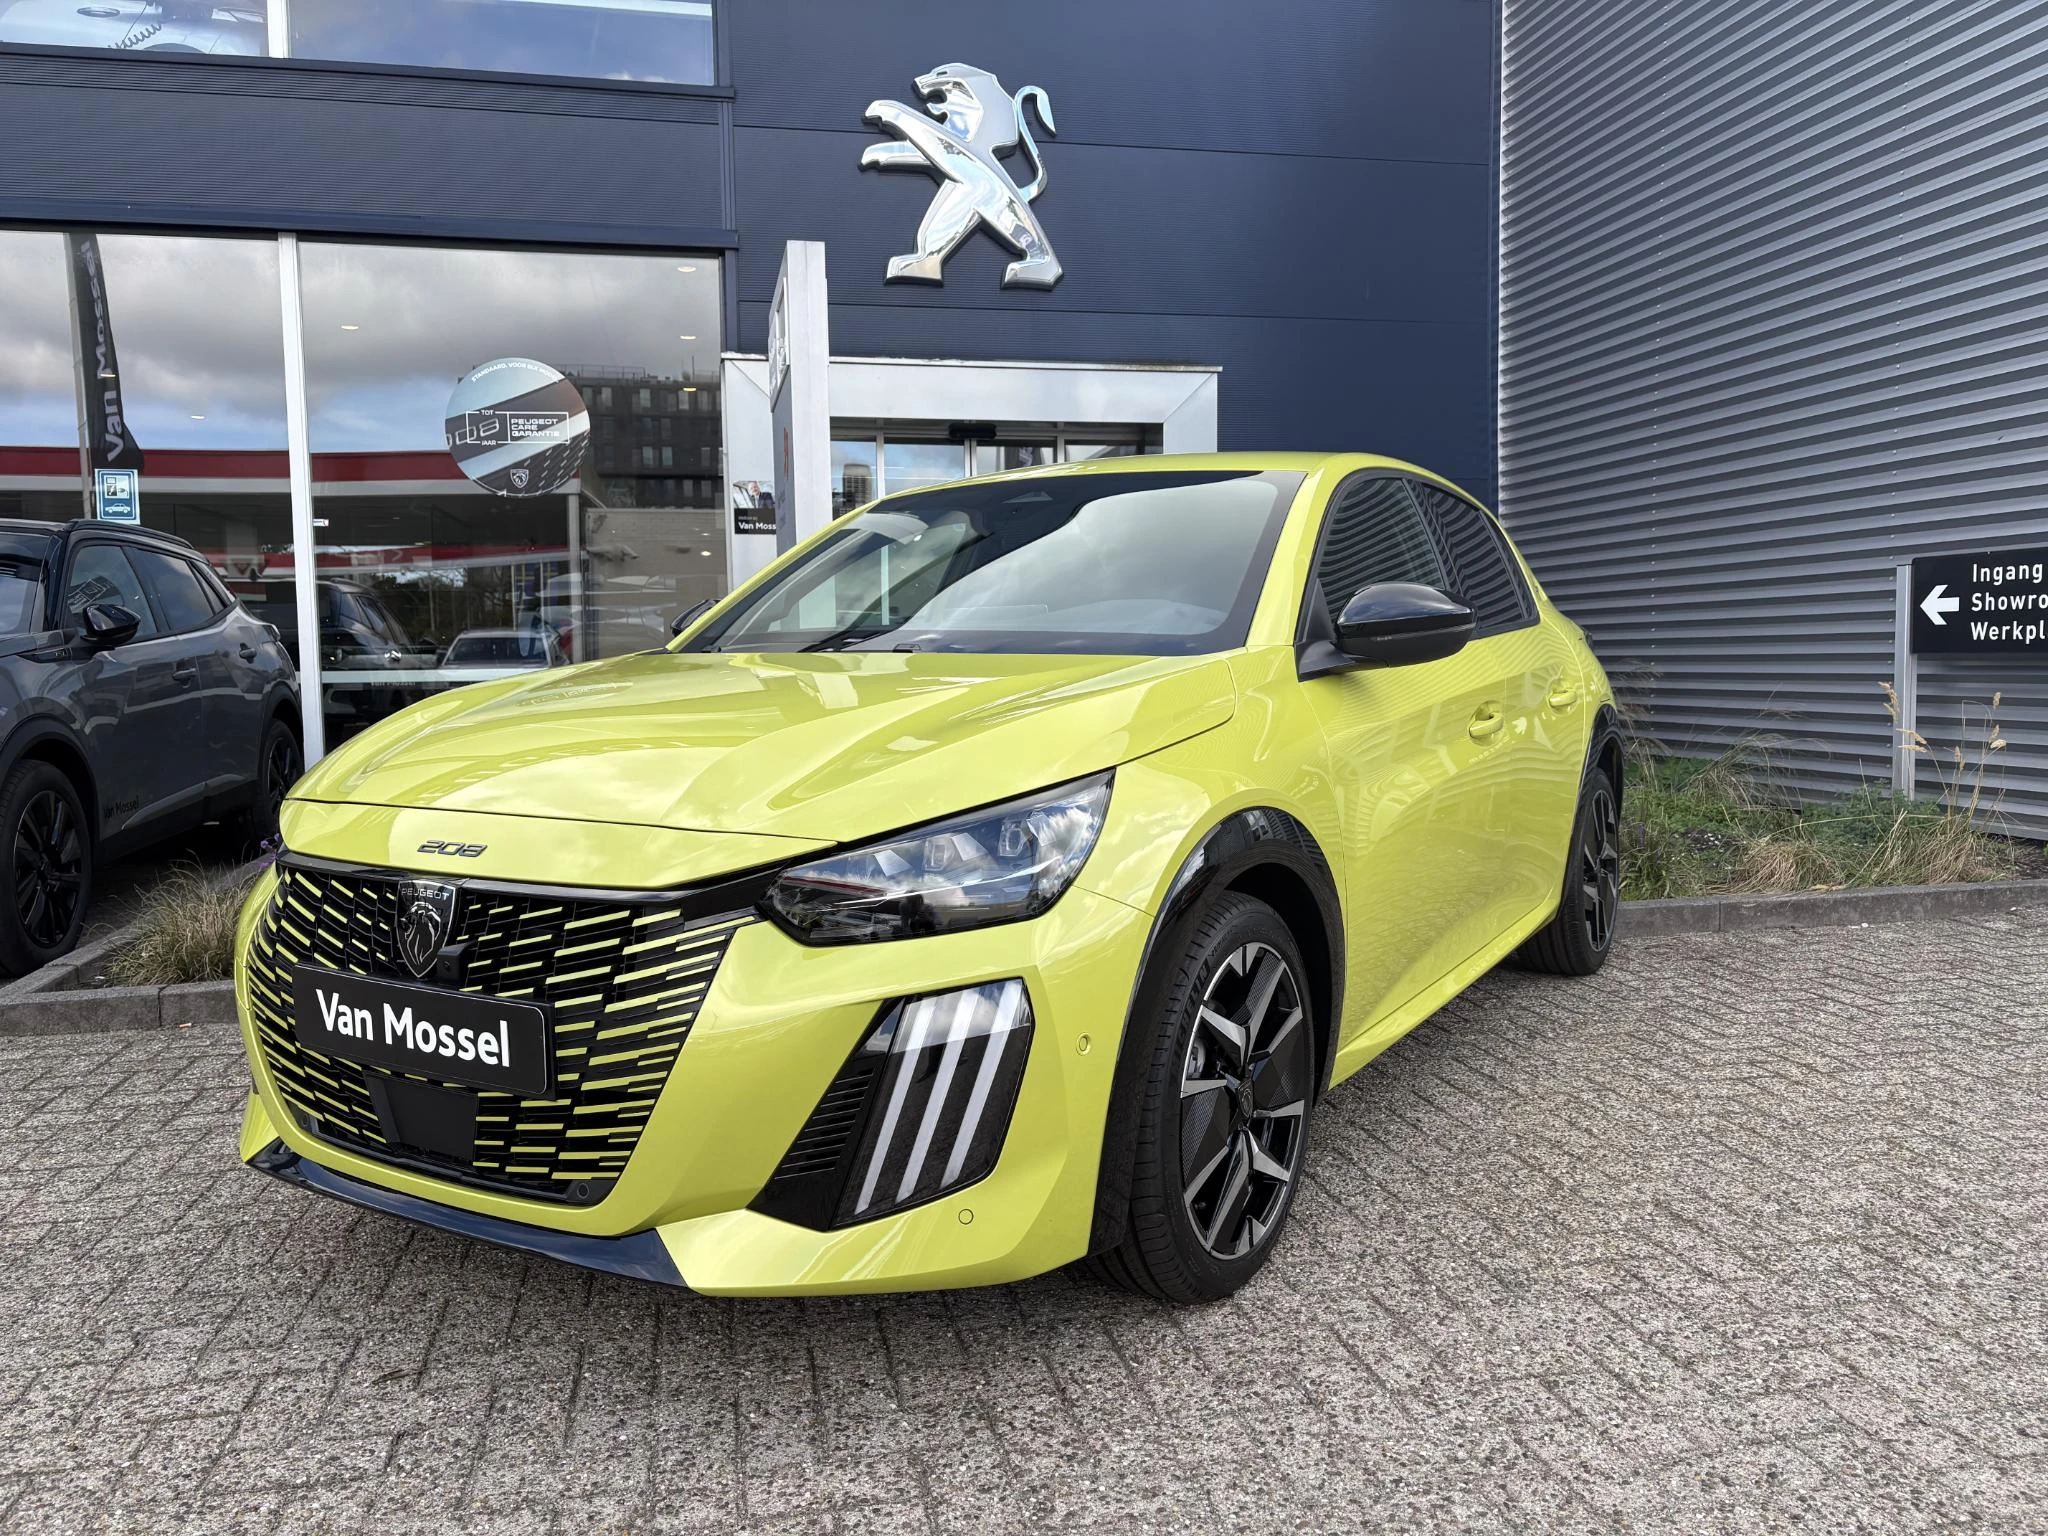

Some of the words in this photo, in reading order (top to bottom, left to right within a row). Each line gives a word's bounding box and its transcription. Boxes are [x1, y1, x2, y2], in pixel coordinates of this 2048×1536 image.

[81, 240, 113, 379] Mossel
[105, 391, 124, 461] Van
[738, 522, 753, 530] Van
[1973, 564, 2043, 585] Ingang
[1971, 592, 2048, 611] Showro
[1971, 620, 2048, 644] Werkpl
[417, 840, 488, 857] 208
[401, 887, 450, 901] PEUGEOT
[316, 989, 373, 1040] Van
[383, 1003, 509, 1067] Mossel
